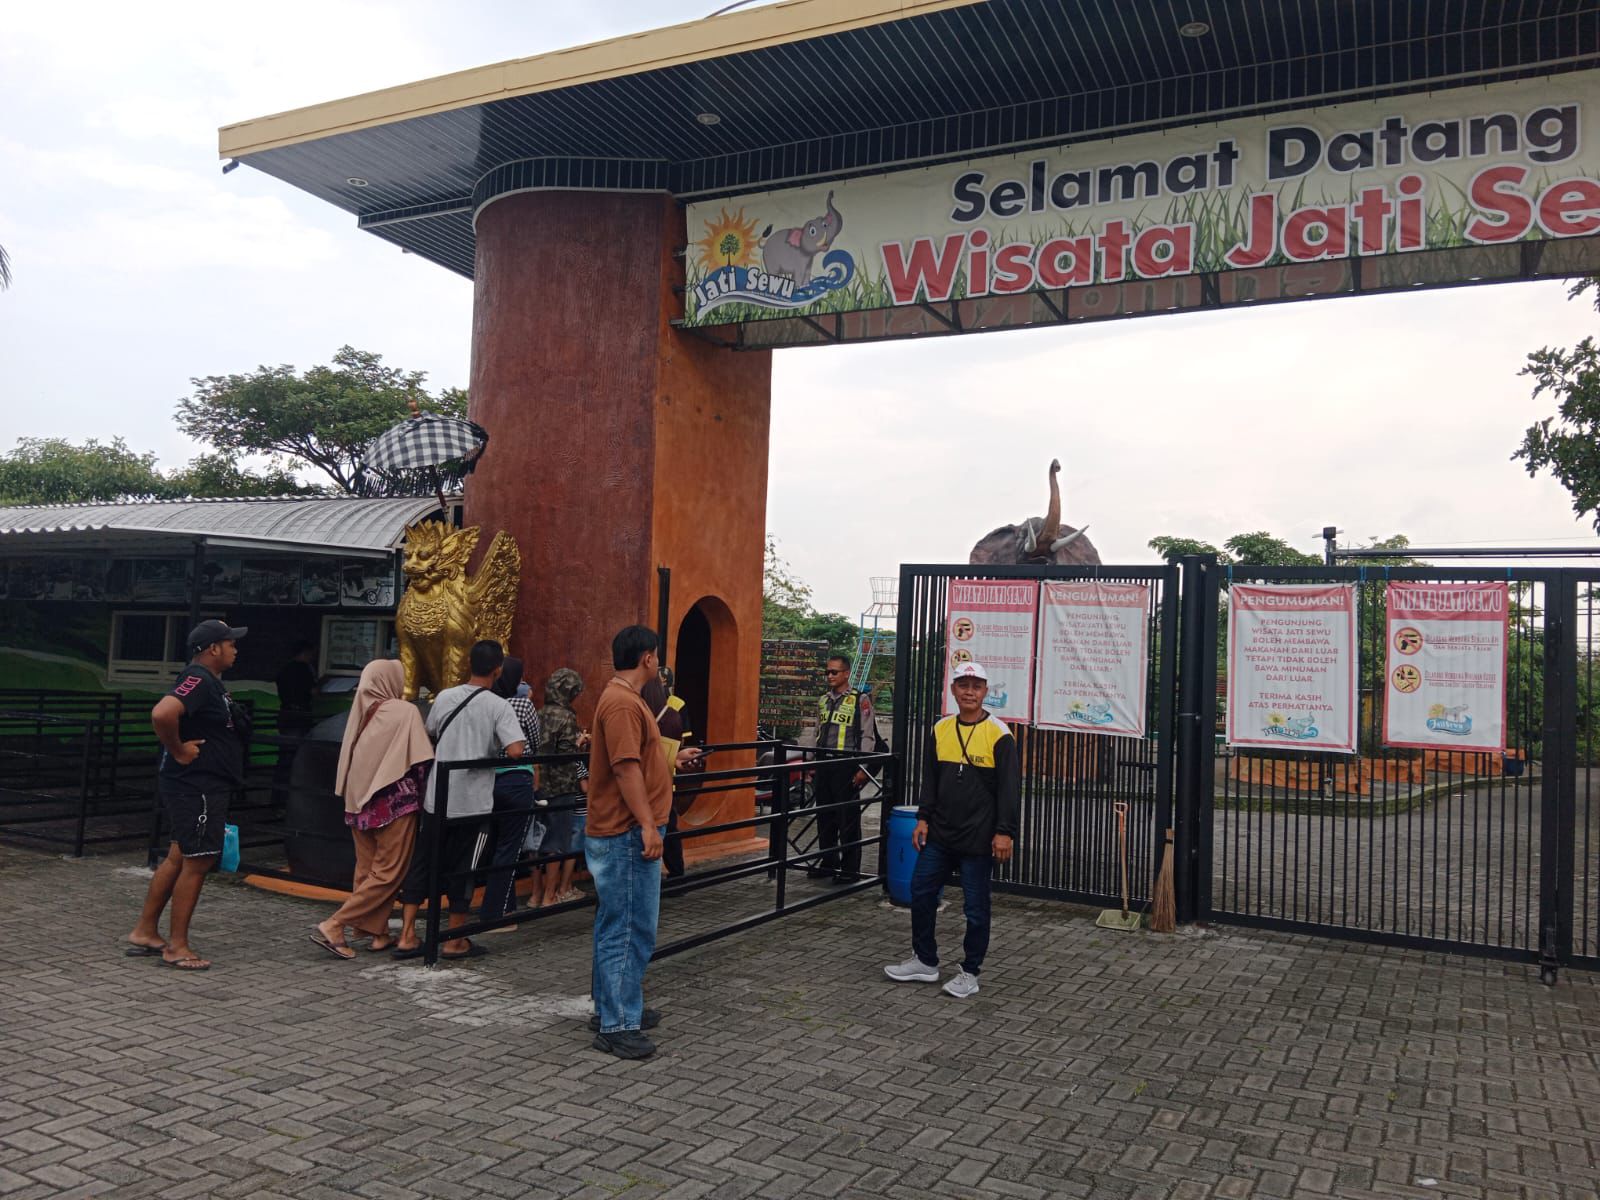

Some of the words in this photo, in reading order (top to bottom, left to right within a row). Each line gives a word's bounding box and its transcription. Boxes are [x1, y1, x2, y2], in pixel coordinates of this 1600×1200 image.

[951, 141, 1239, 223] Selamat
[1268, 104, 1579, 181] Datang
[880, 220, 1193, 304] Wisata
[1225, 174, 1422, 266] Jati
[694, 267, 736, 306] Jati
[746, 268, 795, 299] Sewu
[1240, 595, 1344, 606] PENGUMUMAN!
[1467, 589, 1502, 612] SEWU
[1286, 628, 1304, 636] JATI
[1278, 655, 1305, 663] TIDAK
[1308, 656, 1337, 664] BOLEH
[1255, 664, 1279, 672] BAWA
[1281, 665, 1327, 673] MINUMAN
[1290, 674, 1312, 682] LUAR
[1259, 692, 1292, 700] TERIMA
[1295, 693, 1322, 701] KASIH
[1248, 701, 1269, 709] ATAS
